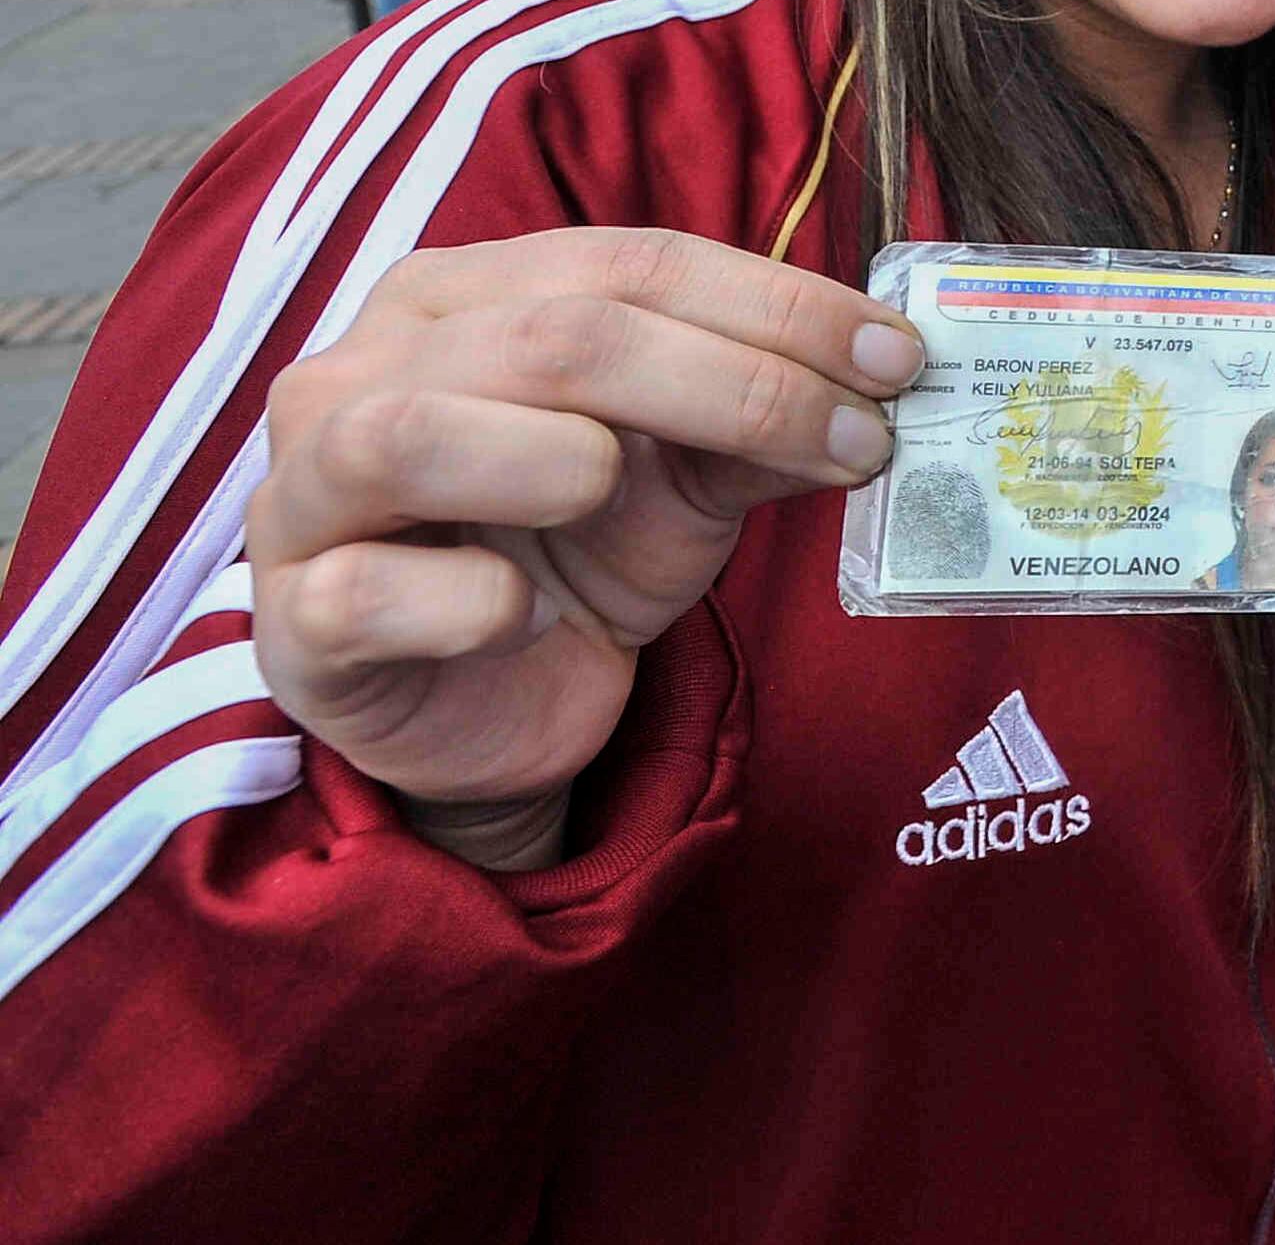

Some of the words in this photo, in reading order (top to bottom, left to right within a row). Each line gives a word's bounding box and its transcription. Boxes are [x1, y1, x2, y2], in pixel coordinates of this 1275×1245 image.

[958, 281, 1069, 295] REPUBLICA
[1076, 286, 1204, 300] BOLIVARIANA
[1210, 291, 1232, 302] DE
[988, 309, 1096, 323] CEDULA
[1114, 314, 1143, 325] DE
[1085, 336, 1097, 350] V
[1113, 337, 1194, 353] 23.547.079
[974, 358, 1034, 374] BARON
[1037, 359, 1094, 375] PEREZ
[971, 382, 1020, 396] KEILY
[1024, 382, 1094, 398] YULIANA
[1027, 456, 1093, 470] 21-06-94
[1023, 507, 1090, 521] 12-03-14
[1095, 506, 1171, 522] 03-2024
[1009, 556, 1181, 577] VENEZOLANO
[895, 794, 1092, 866] adidas
